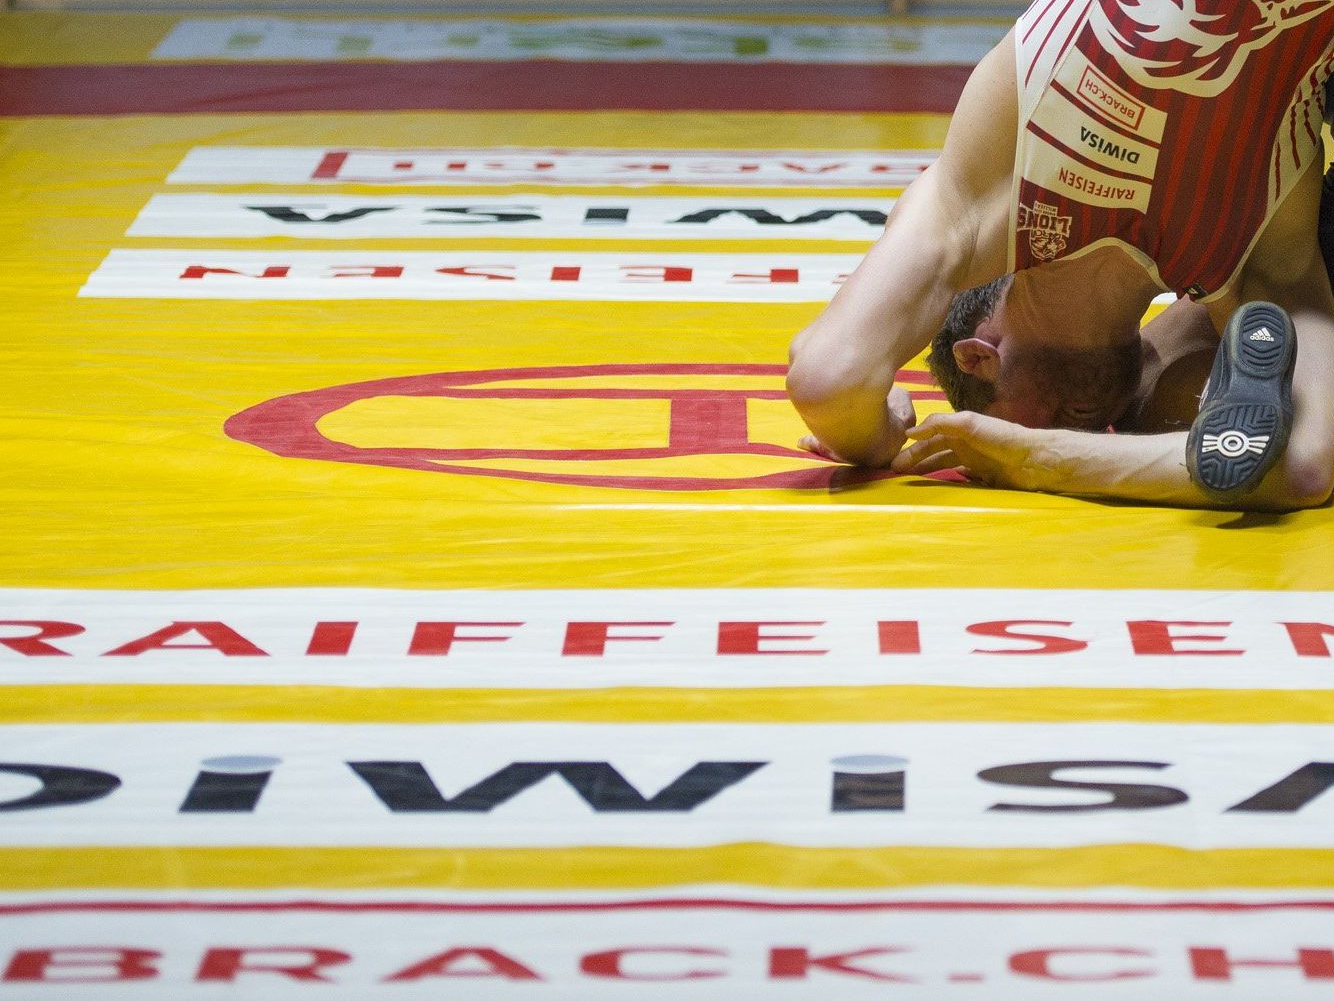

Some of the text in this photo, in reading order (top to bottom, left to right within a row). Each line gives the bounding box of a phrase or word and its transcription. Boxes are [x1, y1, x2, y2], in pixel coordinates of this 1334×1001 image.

[1085, 78, 1135, 119] BRACK.CH
[1059, 167, 1135, 200] RAIFFEISEN
[1017, 206, 1070, 235] LIONS
[178, 263, 851, 286] FEISEN
